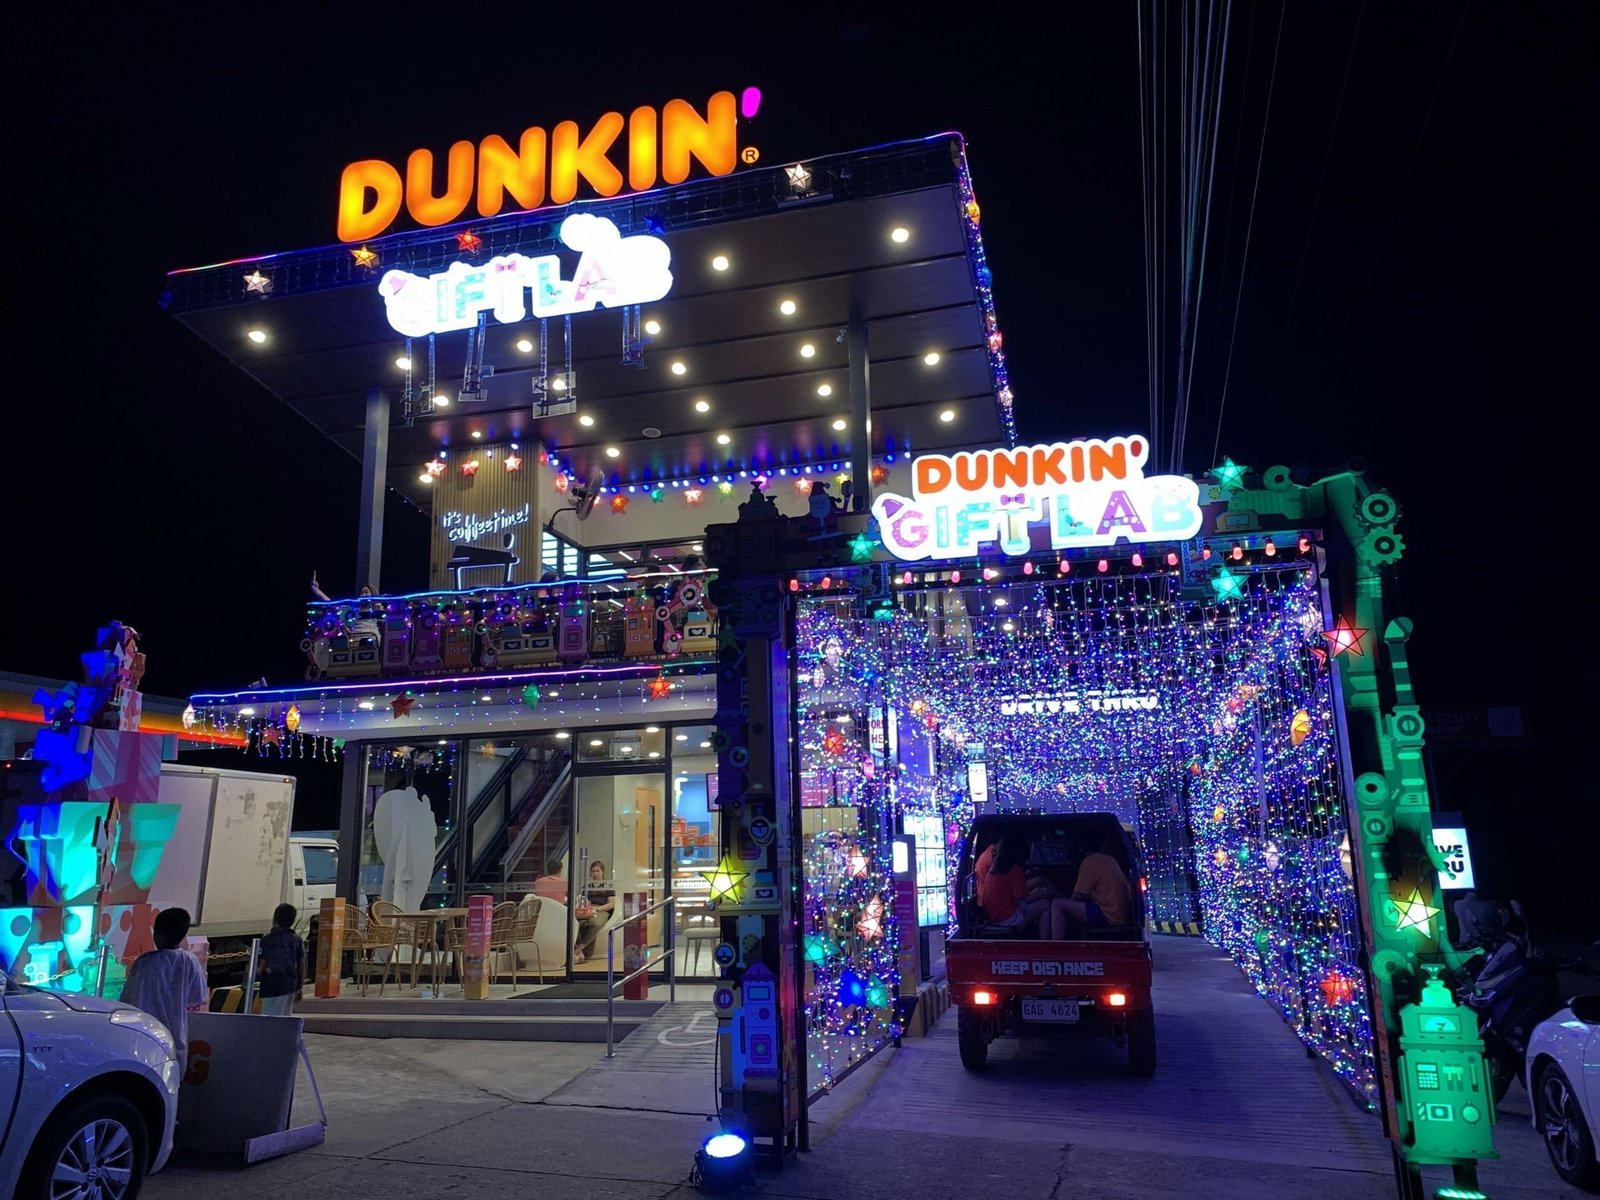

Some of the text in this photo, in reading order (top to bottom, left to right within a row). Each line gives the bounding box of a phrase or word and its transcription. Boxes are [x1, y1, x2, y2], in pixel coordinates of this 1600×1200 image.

[337, 86, 761, 243] DUNKIN'
[917, 440, 1142, 494] DUNKIN'
[889, 484, 1196, 548] GIFT LAB
[991, 960, 1105, 976] KEEP DISTANCE
[1023, 1003, 1077, 1016] GAG 4624
